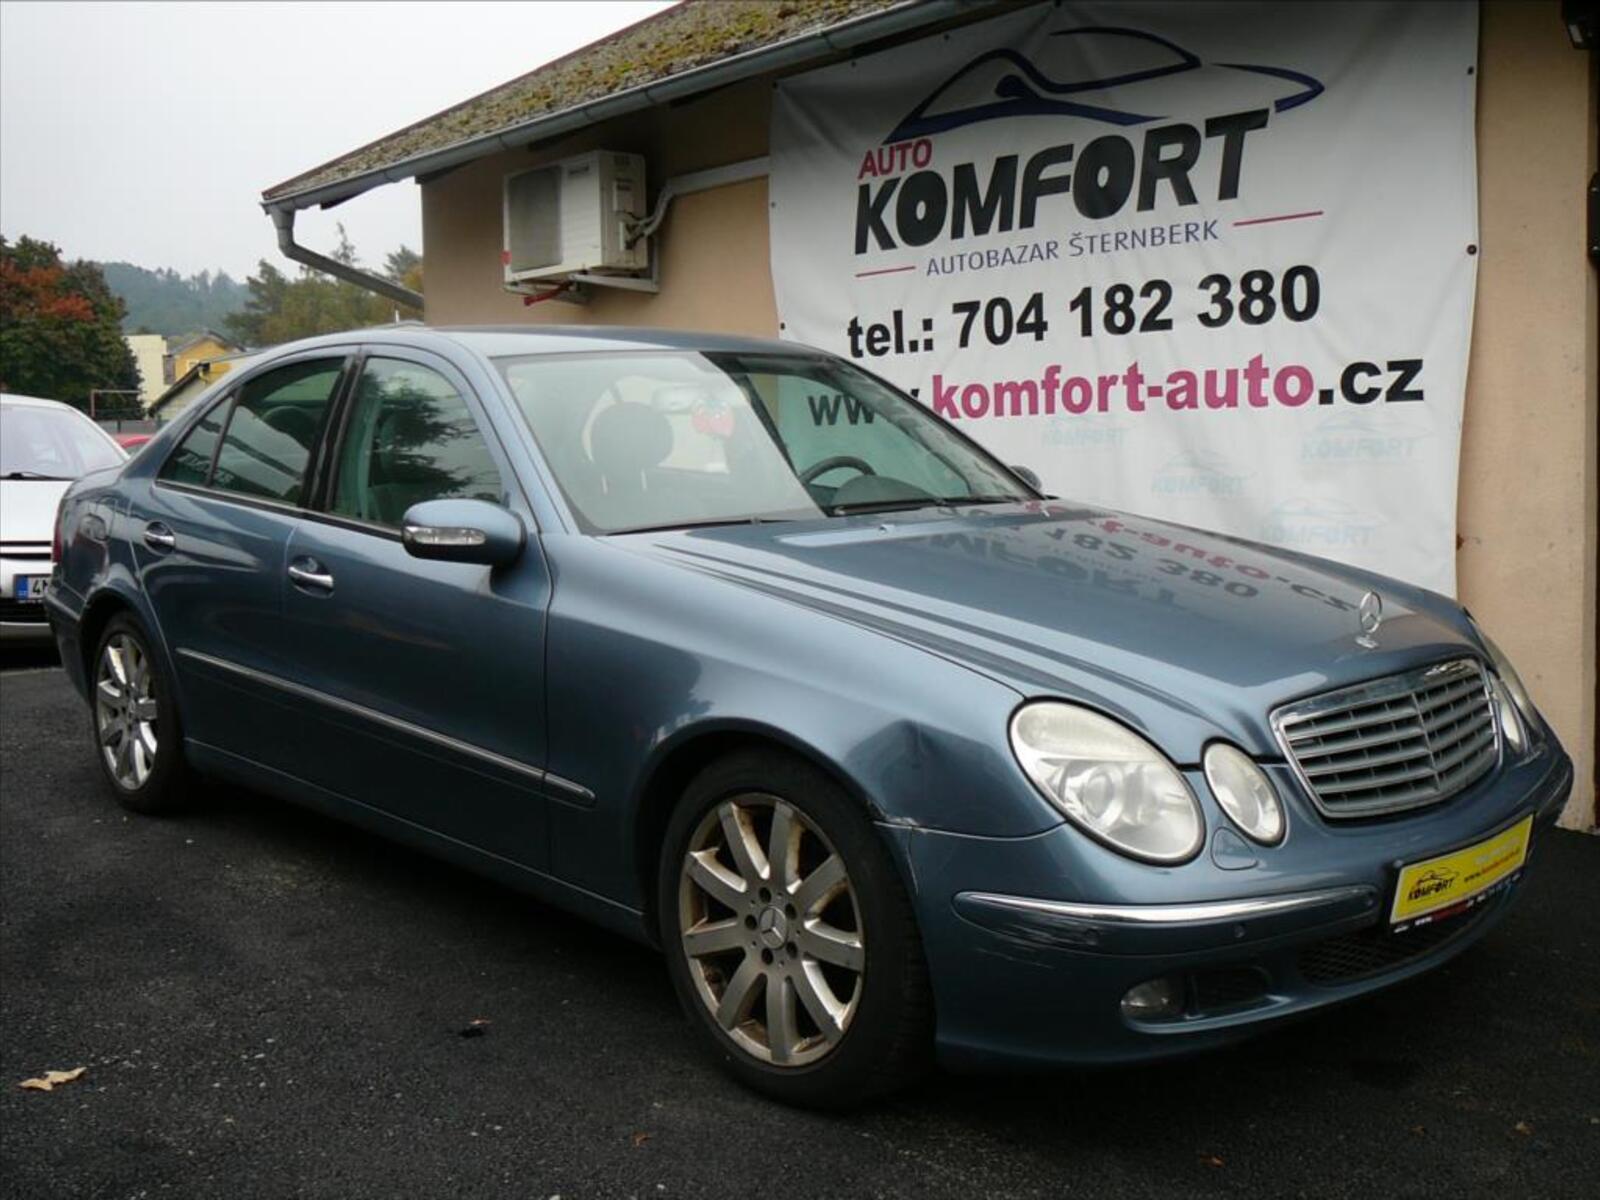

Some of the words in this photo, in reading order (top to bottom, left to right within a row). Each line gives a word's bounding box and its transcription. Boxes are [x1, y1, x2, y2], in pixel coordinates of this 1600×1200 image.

[855, 108, 1270, 255] KOMFORT
[857, 138, 932, 180] AUTO
[926, 241, 1059, 277] AUTOBAZAR
[1068, 219, 1219, 257] ŠTERNBERK
[847, 310, 934, 359] tel.:
[952, 292, 1048, 348] 704
[1069, 279, 1174, 338] 182
[1196, 264, 1321, 329] 380
